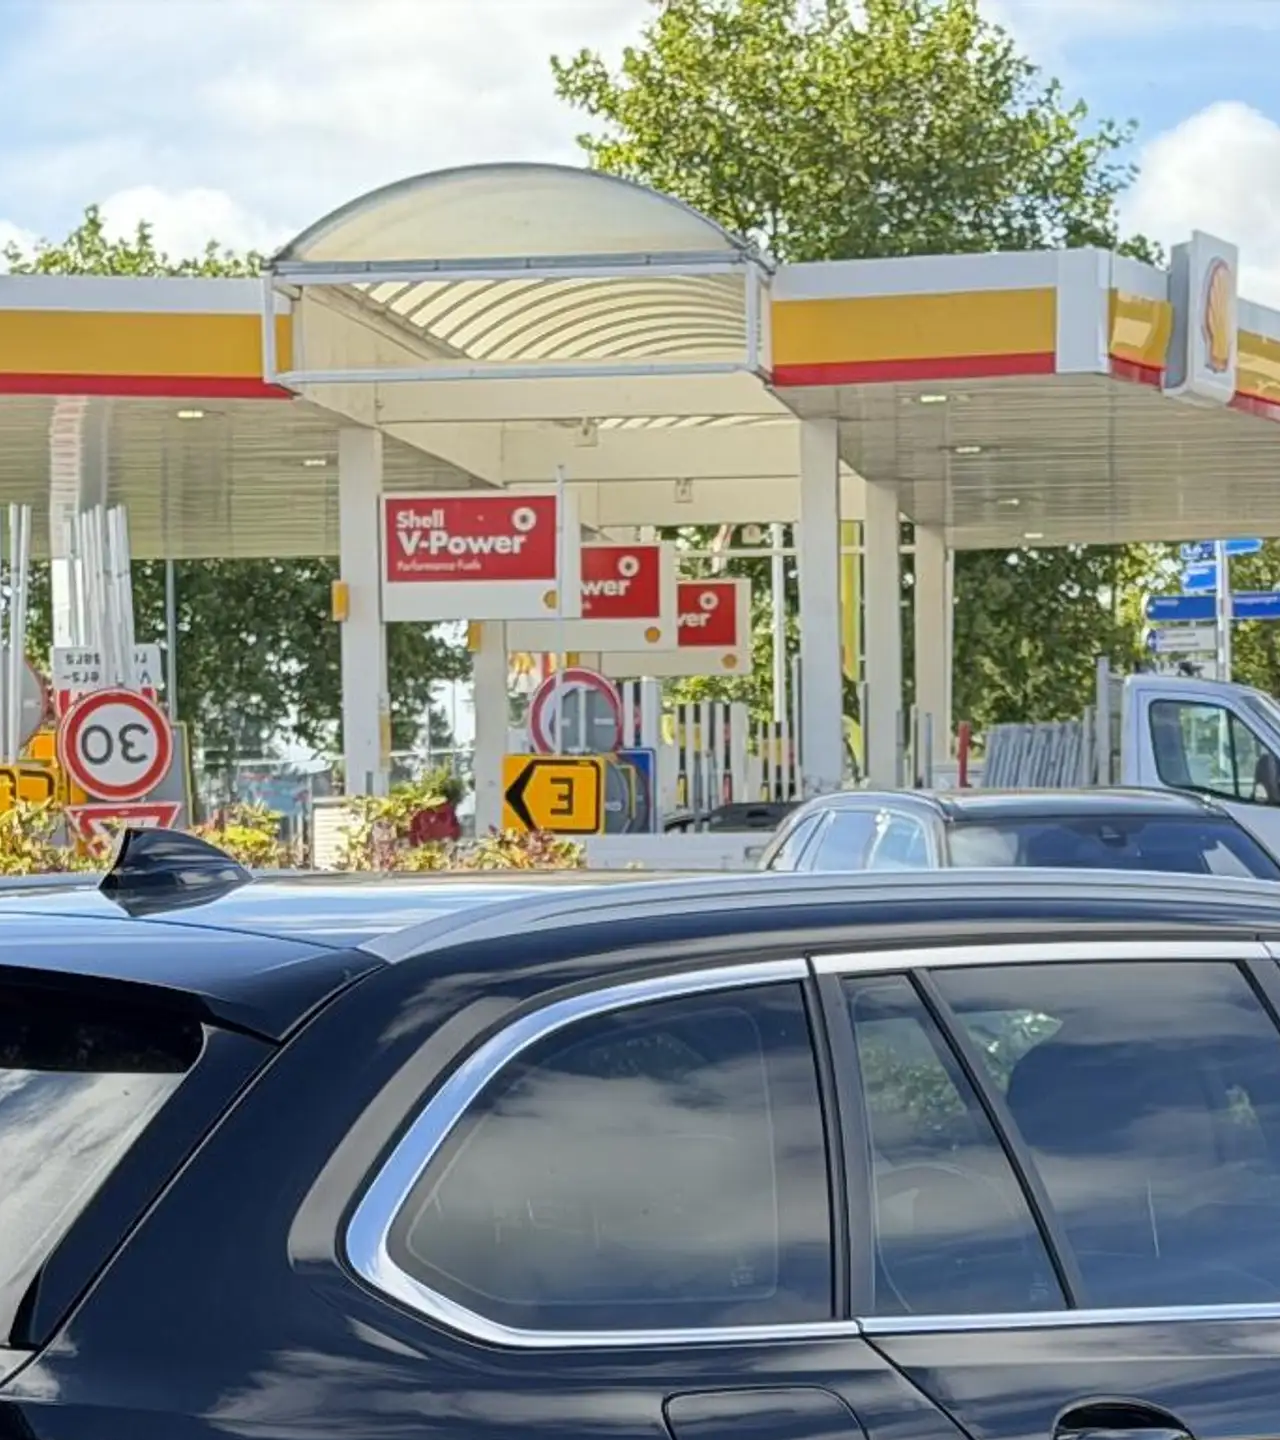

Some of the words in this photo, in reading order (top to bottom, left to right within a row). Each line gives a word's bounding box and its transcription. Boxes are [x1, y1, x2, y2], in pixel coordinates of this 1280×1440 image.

[396, 509, 445, 529] Shell
[397, 530, 527, 556] V-Power
[81, 723, 149, 765] 30
